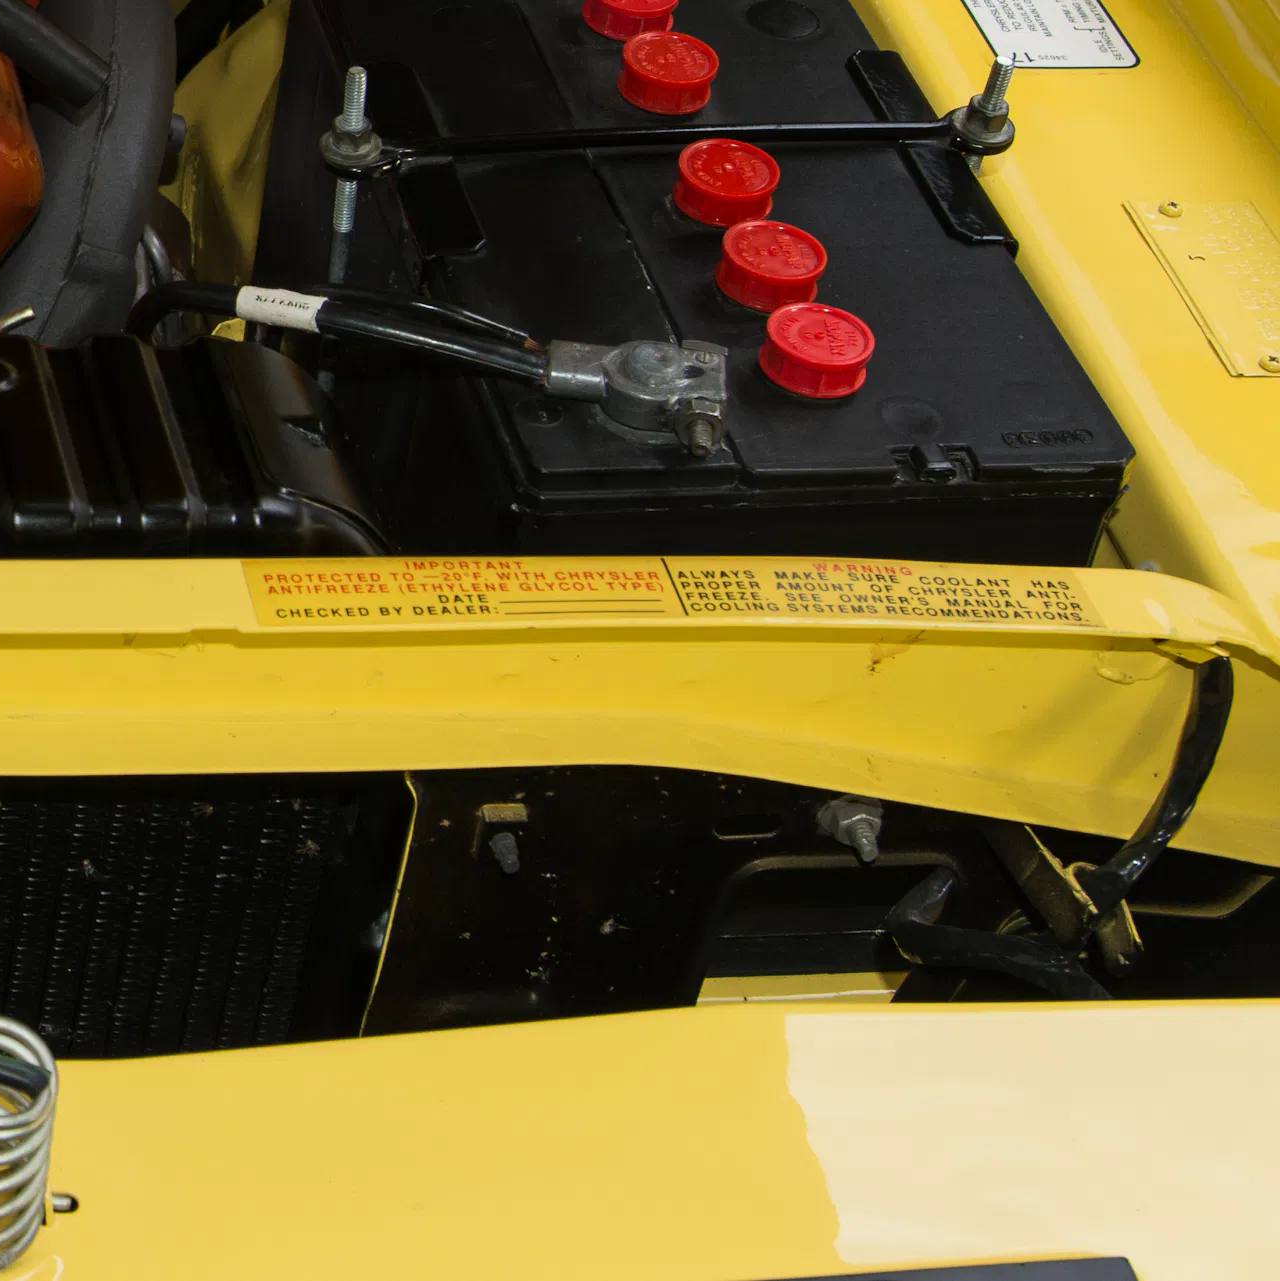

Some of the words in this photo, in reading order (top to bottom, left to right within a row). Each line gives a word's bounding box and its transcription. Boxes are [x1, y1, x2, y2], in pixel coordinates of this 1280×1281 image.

[984, 0, 1010, 32] CHRYSLER
[1013, 3, 1037, 31] REGULAR
[1061, 10, 1076, 23] RPM
[1071, 2, 1091, 22] TIMING
[1028, 8, 1052, 37] MAINTAIN
[1093, 39, 1109, 53] IDLE
[1098, 31, 1125, 60] SETTINGS
[404, 560, 525, 571] IMPORTANT
[811, 562, 913, 577] WARNING
[263, 573, 381, 584] PROTECTED
[391, 572, 414, 582] TO
[496, 571, 547, 582] WITH
[554, 570, 661, 581] CHRYSLER
[676, 570, 756, 581] ALWAYS
[774, 571, 829, 582] MAKE
[847, 572, 900, 585] SURE
[919, 575, 1014, 589] COOLANT
[1030, 579, 1070, 591] HAS
[267, 583, 390, 595] ANTIFREEZE
[398, 582, 509, 595] (ETHYLENE
[519, 581, 598, 593] GLYCOL
[607, 581, 665, 593] TYPE)
[680, 580, 761, 591] PROPER
[775, 581, 856, 593] AMOUNT
[869, 583, 894, 594] OF
[907, 584, 1012, 599] CHRYSLER
[1025, 589, 1076, 602] ANTI-
[438, 594, 490, 605] DATE
[685, 590, 769, 602] FREEZE.
[784, 592, 827, 603] SEE
[839, 594, 930, 607] OWNER'S
[946, 597, 1028, 611] MANUAL
[1044, 600, 1083, 612] FOR
[276, 606, 370, 619] CHECKED
[380, 606, 404, 617] BY
[413, 604, 501, 617] DEALER:
[690, 601, 781, 614] COOLING
[787, 603, 879, 616] SYSTEMS
[886, 604, 1090, 622] RECOMMENDATIONS.
